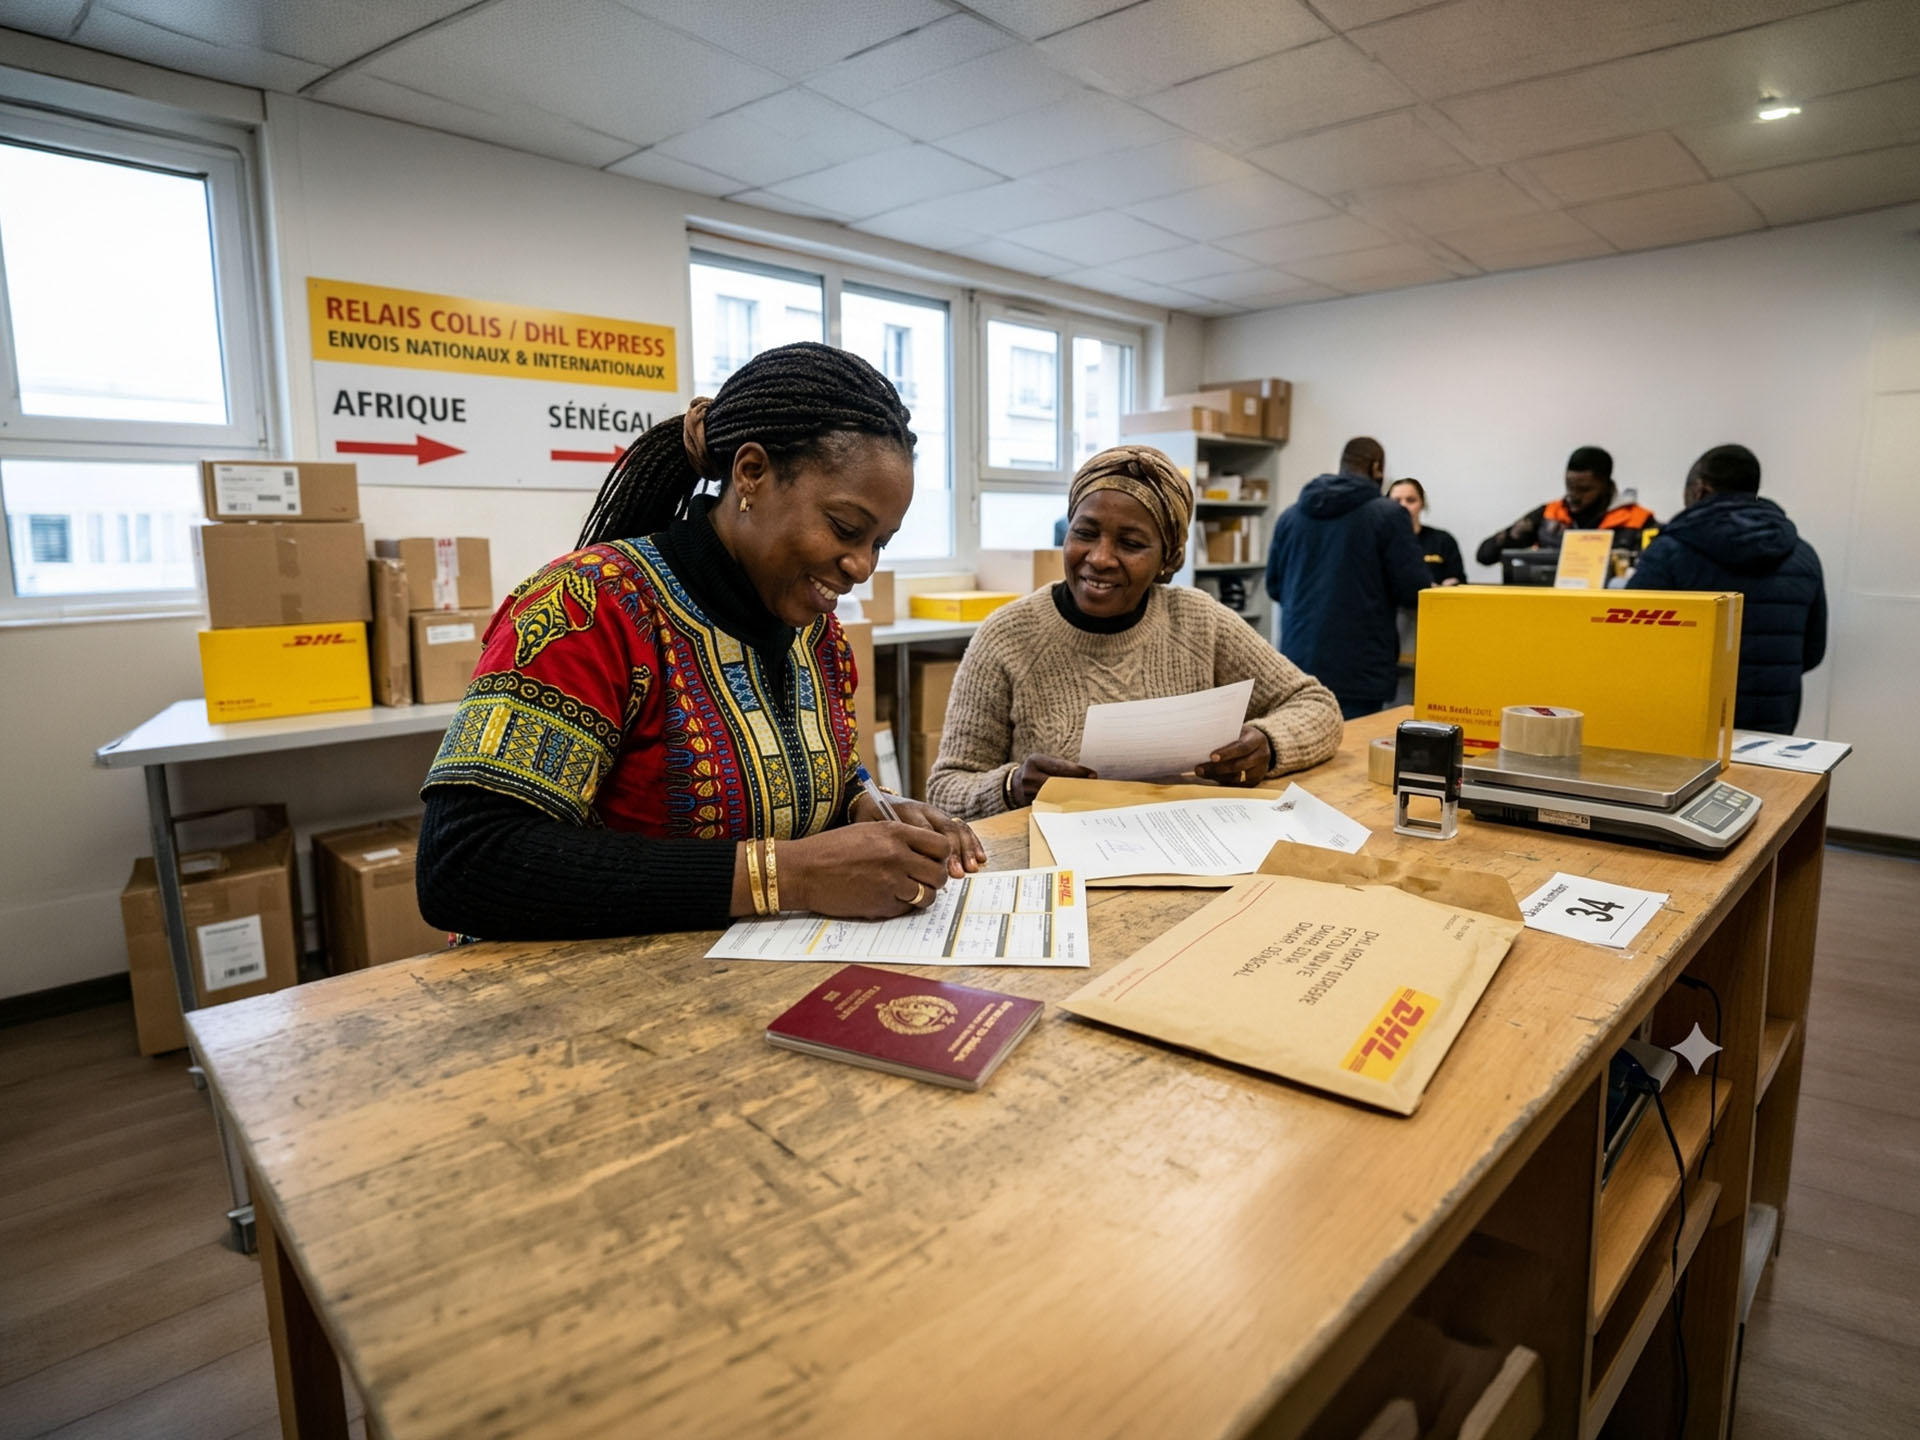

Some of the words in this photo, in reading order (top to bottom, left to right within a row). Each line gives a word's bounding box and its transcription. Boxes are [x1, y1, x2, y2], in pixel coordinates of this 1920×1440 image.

[326, 296, 421, 329] RELAIS
[430, 310, 501, 338] COLIS
[509, 320, 516, 340] /
[525, 321, 569, 347] DHL
[577, 329, 665, 357] EXPRESS
[328, 330, 399, 353] ENVOIS
[406, 340, 509, 364] NATIONAUX
[516, 351, 527, 366] &
[533, 353, 665, 379] INTERNATIONAUX
[333, 389, 467, 424] AFRIQUE
[1605, 608, 1682, 626] DHL
[293, 633, 346, 647] DHL
[1565, 897, 1625, 922] 34
[1361, 998, 1425, 1061] DHL
